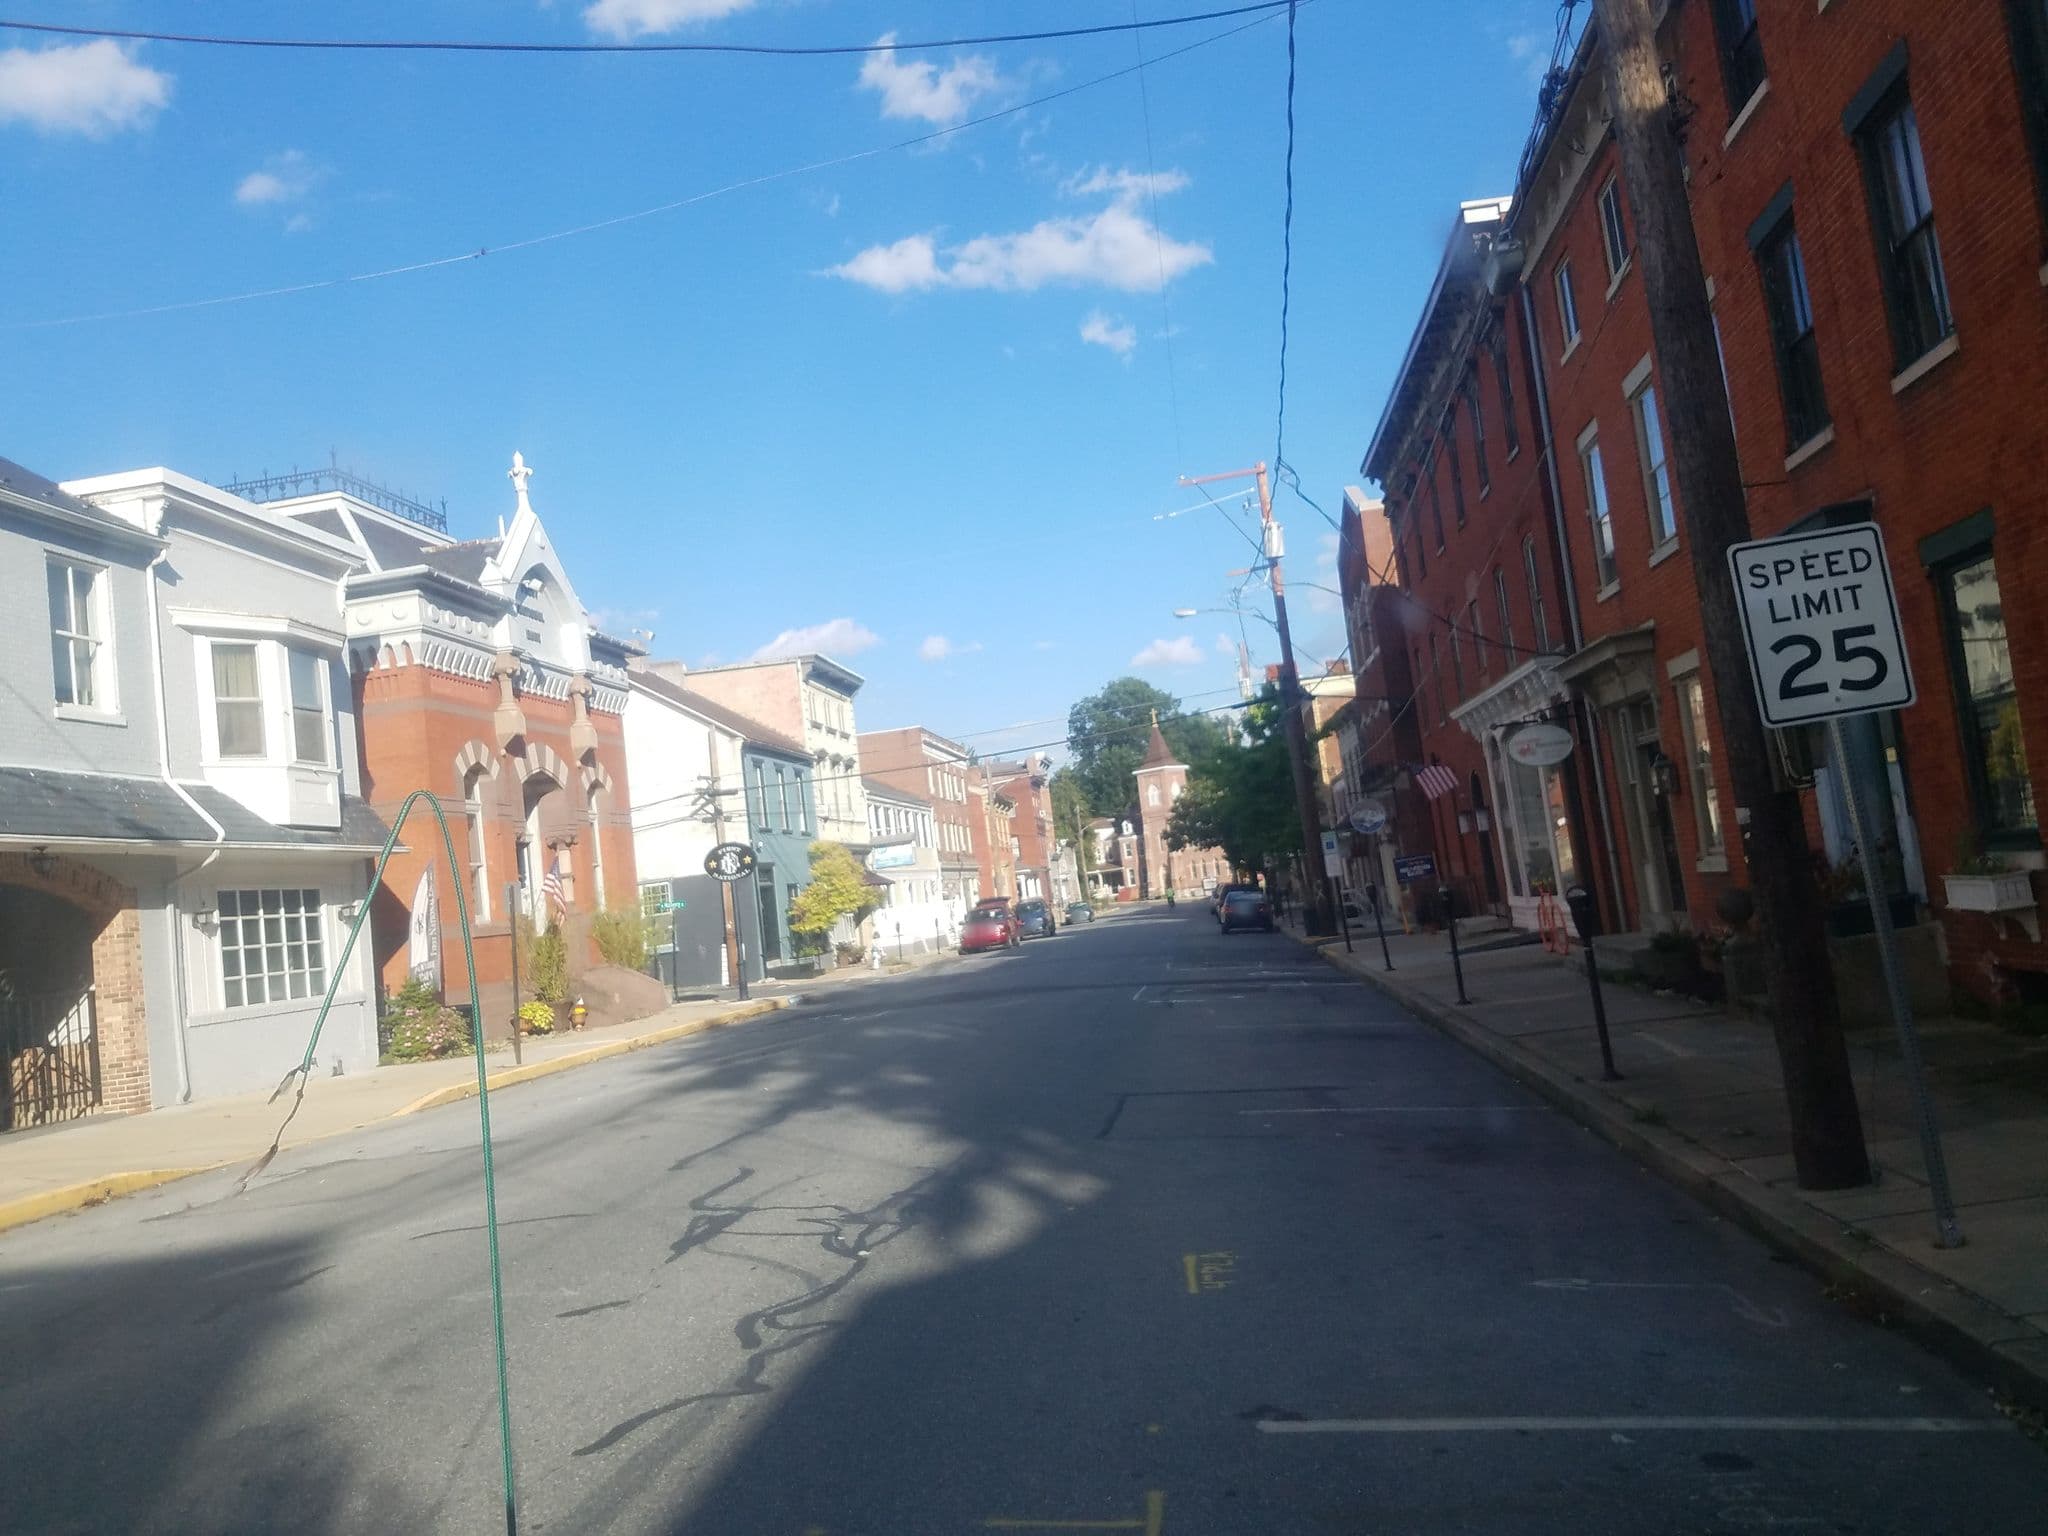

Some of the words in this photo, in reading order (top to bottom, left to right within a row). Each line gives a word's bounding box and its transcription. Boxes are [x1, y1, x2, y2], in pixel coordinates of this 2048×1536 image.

[1749, 547, 1872, 589] SPEED
[1768, 584, 1862, 623] LIMIT
[1769, 624, 1888, 700] 25
[712, 868, 751, 880] NATIONAL
